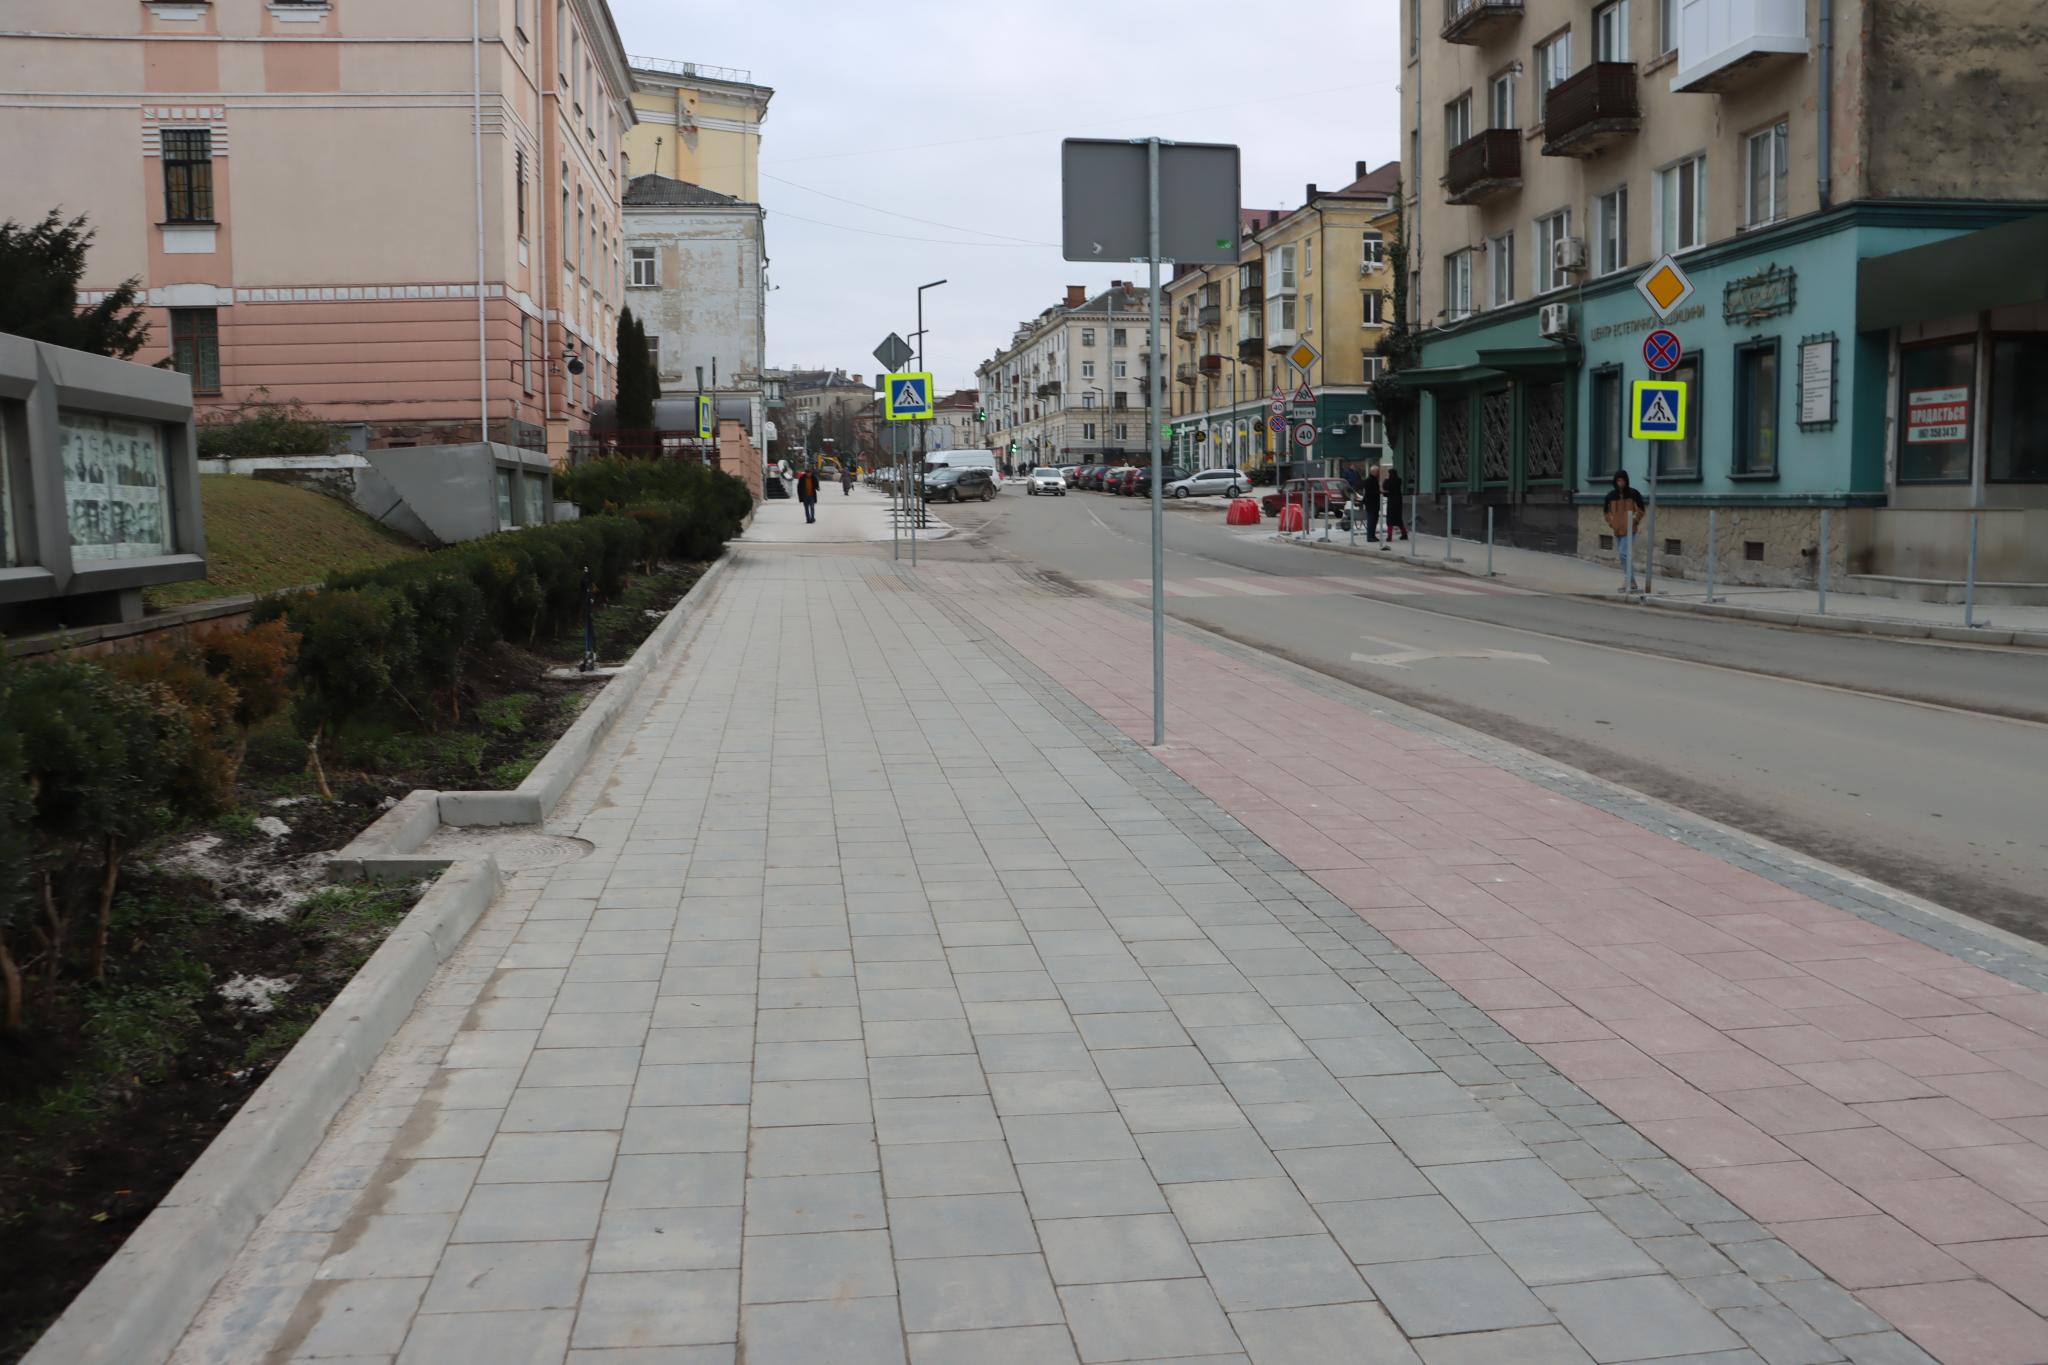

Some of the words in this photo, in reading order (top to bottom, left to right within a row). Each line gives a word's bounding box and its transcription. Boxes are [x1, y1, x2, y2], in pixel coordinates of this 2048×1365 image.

[1591, 326, 1611, 341] ЦЕНТР
[1660, 304, 1705, 327] ЕДИЦИНИ
[1299, 430, 1312, 440] 40
